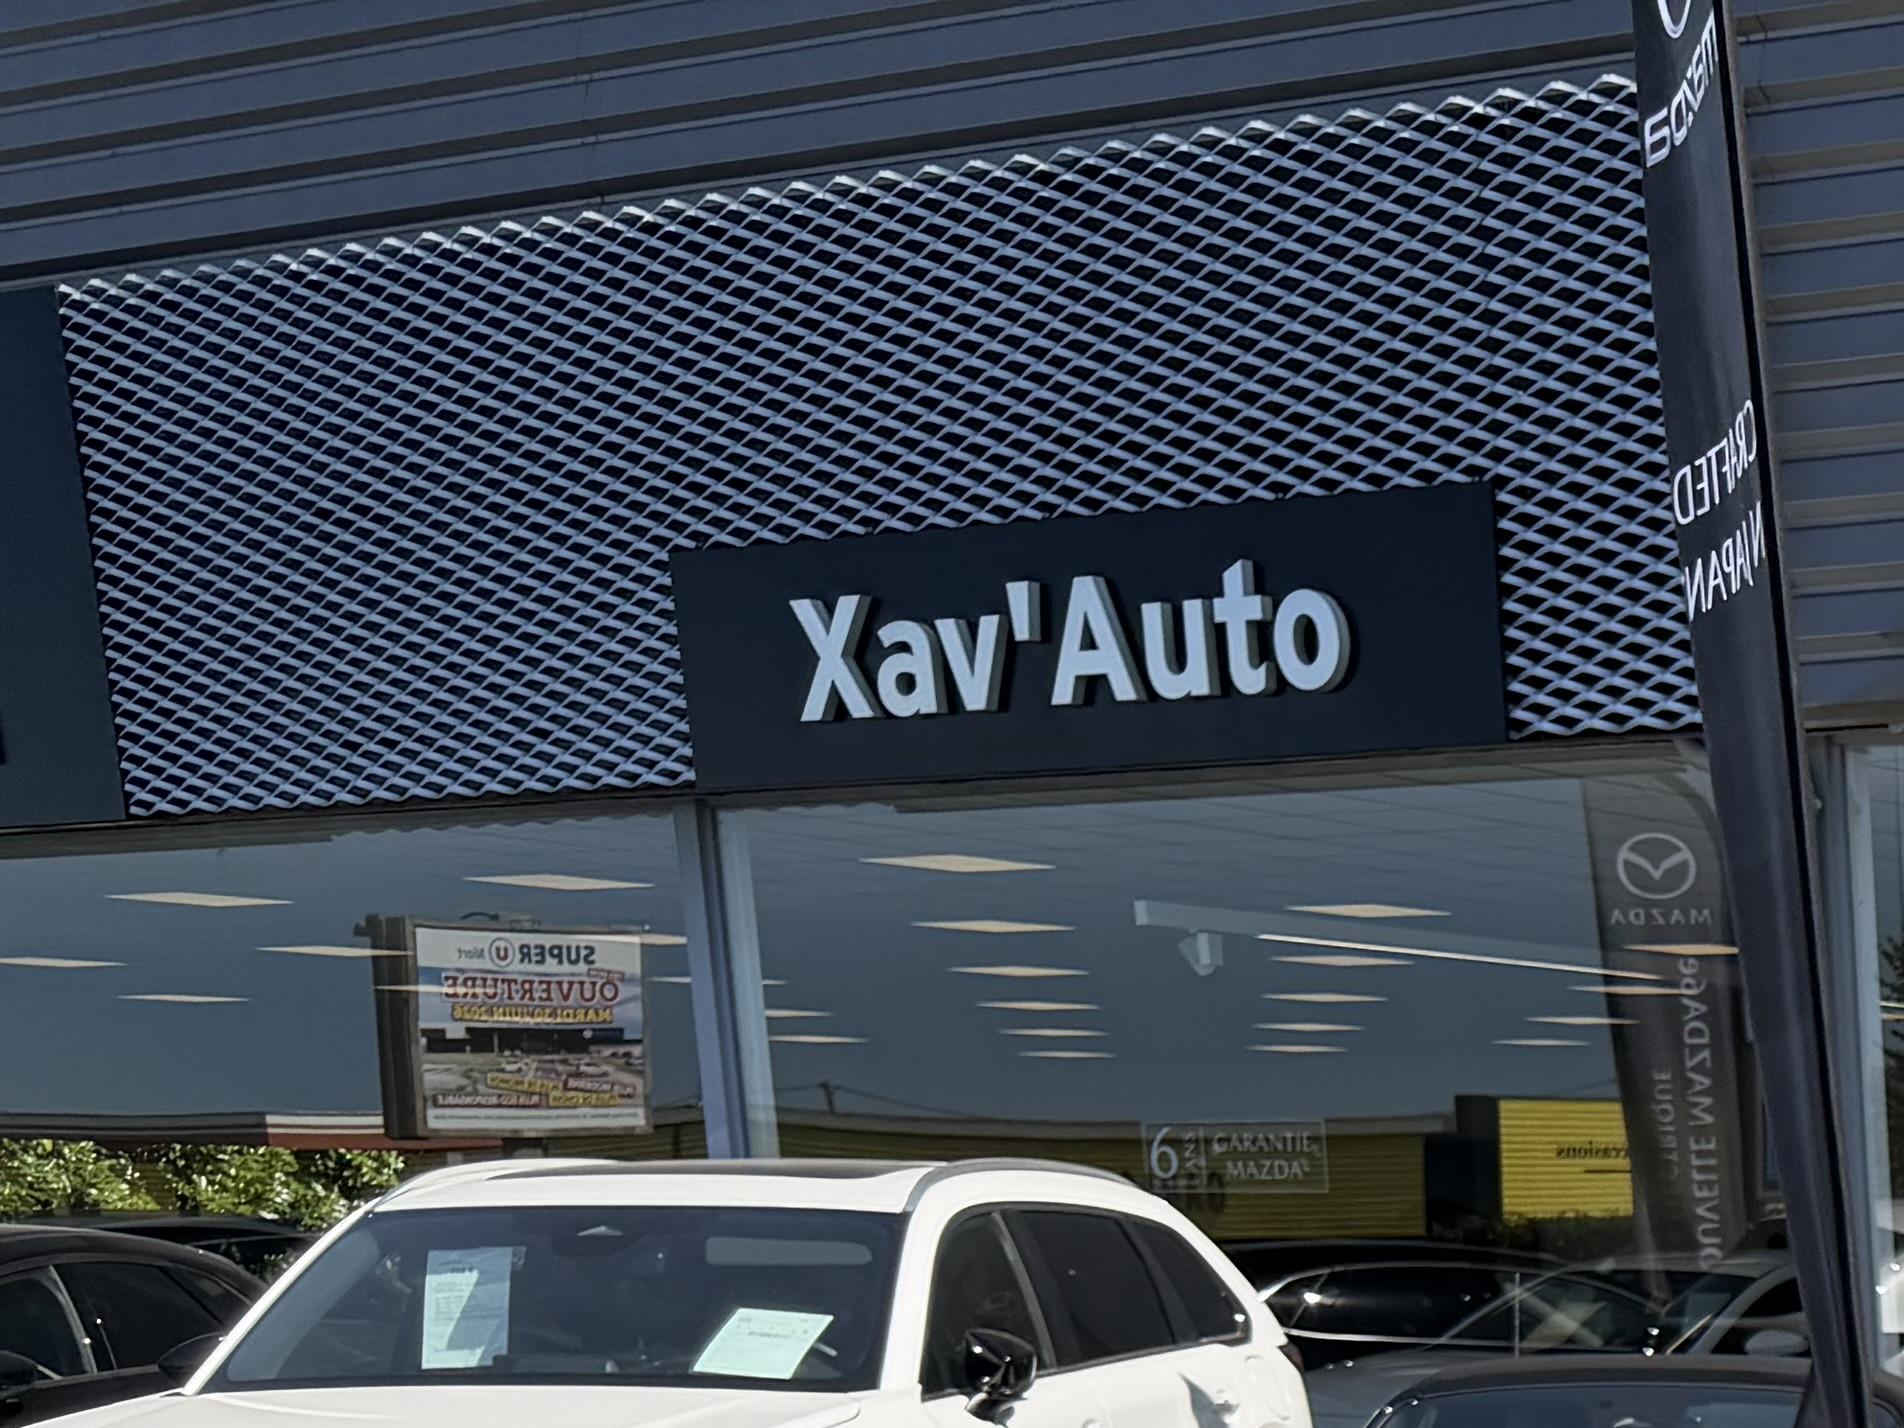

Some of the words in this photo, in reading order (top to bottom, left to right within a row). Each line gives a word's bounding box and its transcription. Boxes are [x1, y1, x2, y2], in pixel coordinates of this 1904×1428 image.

[789, 558, 1352, 722] Xav'Auto
[1150, 1126, 1179, 1179] 6
[1212, 1131, 1314, 1154] GARANTIE
[1225, 1158, 1304, 1181] MAZDA
